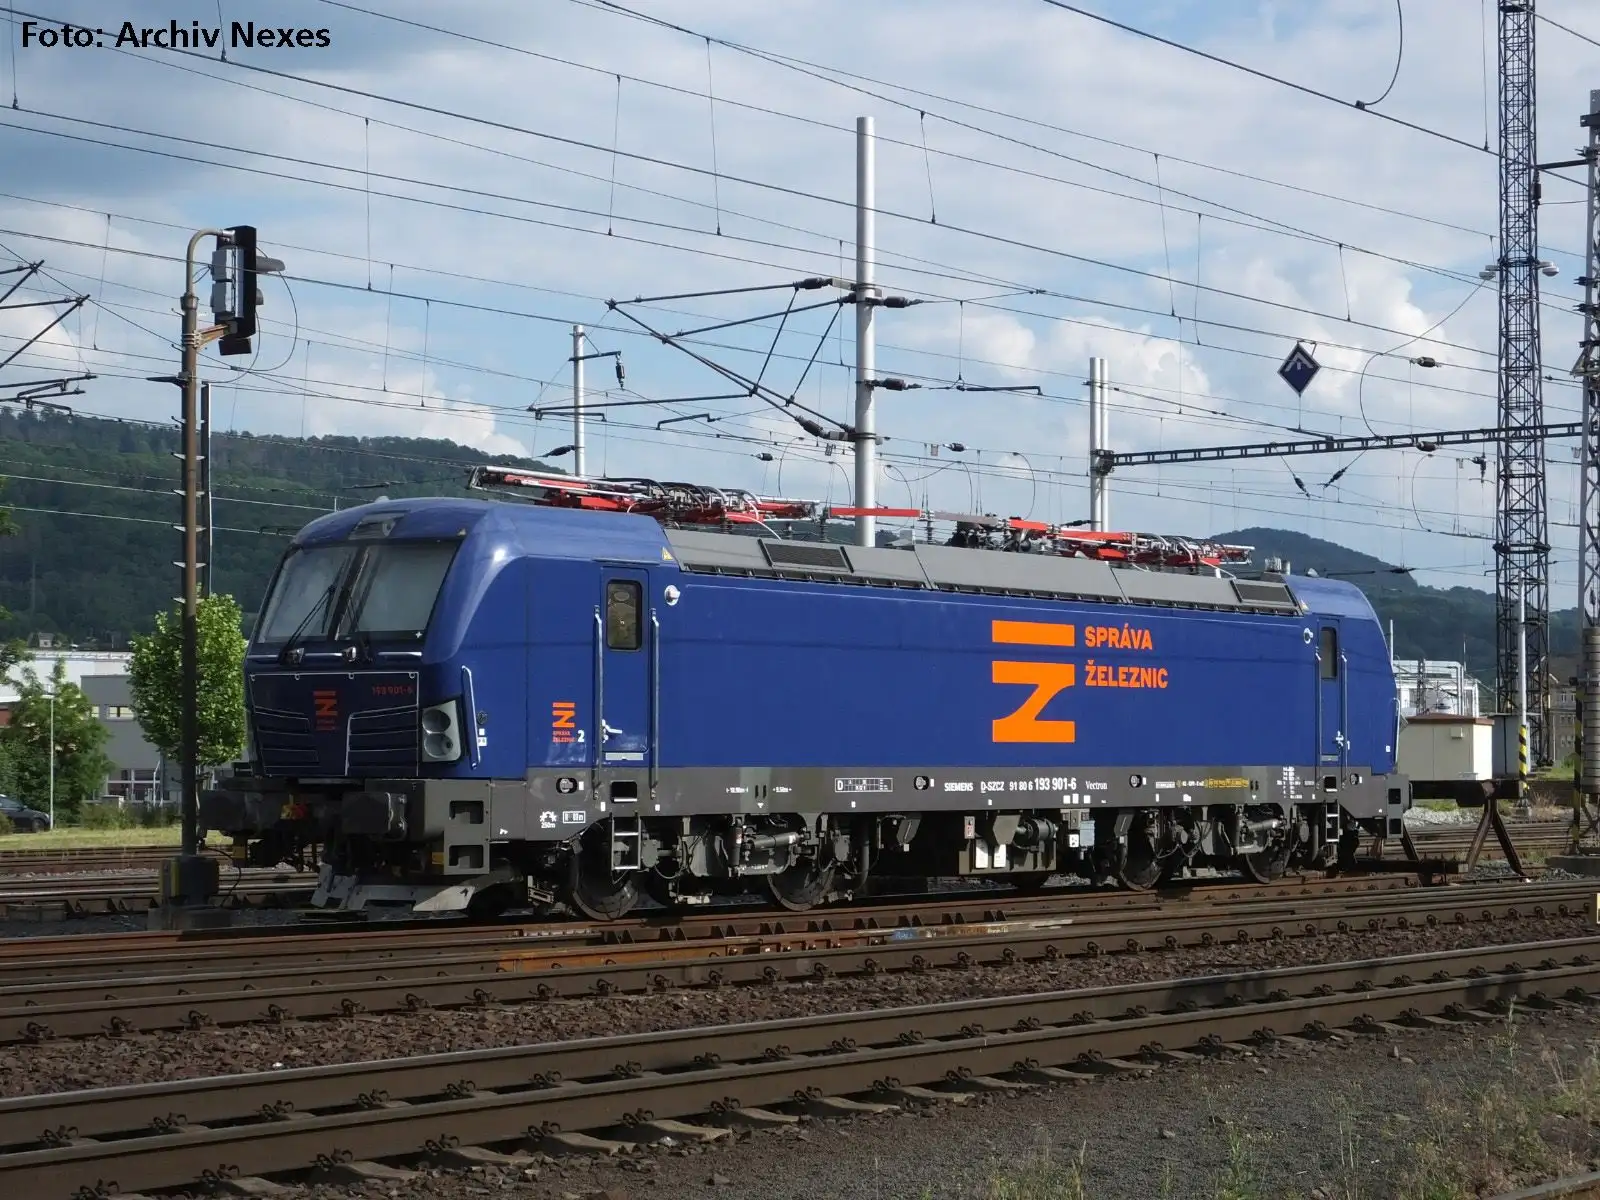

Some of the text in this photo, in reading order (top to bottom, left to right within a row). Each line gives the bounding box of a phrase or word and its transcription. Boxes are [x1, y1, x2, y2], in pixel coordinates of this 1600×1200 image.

[1084, 623, 1153, 650] SPRÁVA
[1084, 660, 1169, 689] ŽELEZNIC
[577, 729, 585, 743] 2
[944, 782, 974, 792] SIEMENS
[1009, 781, 1018, 791] 91
[1034, 777, 1050, 791] 193
[1052, 777, 1077, 790] 901-6
[1085, 780, 1108, 790] Vectron
